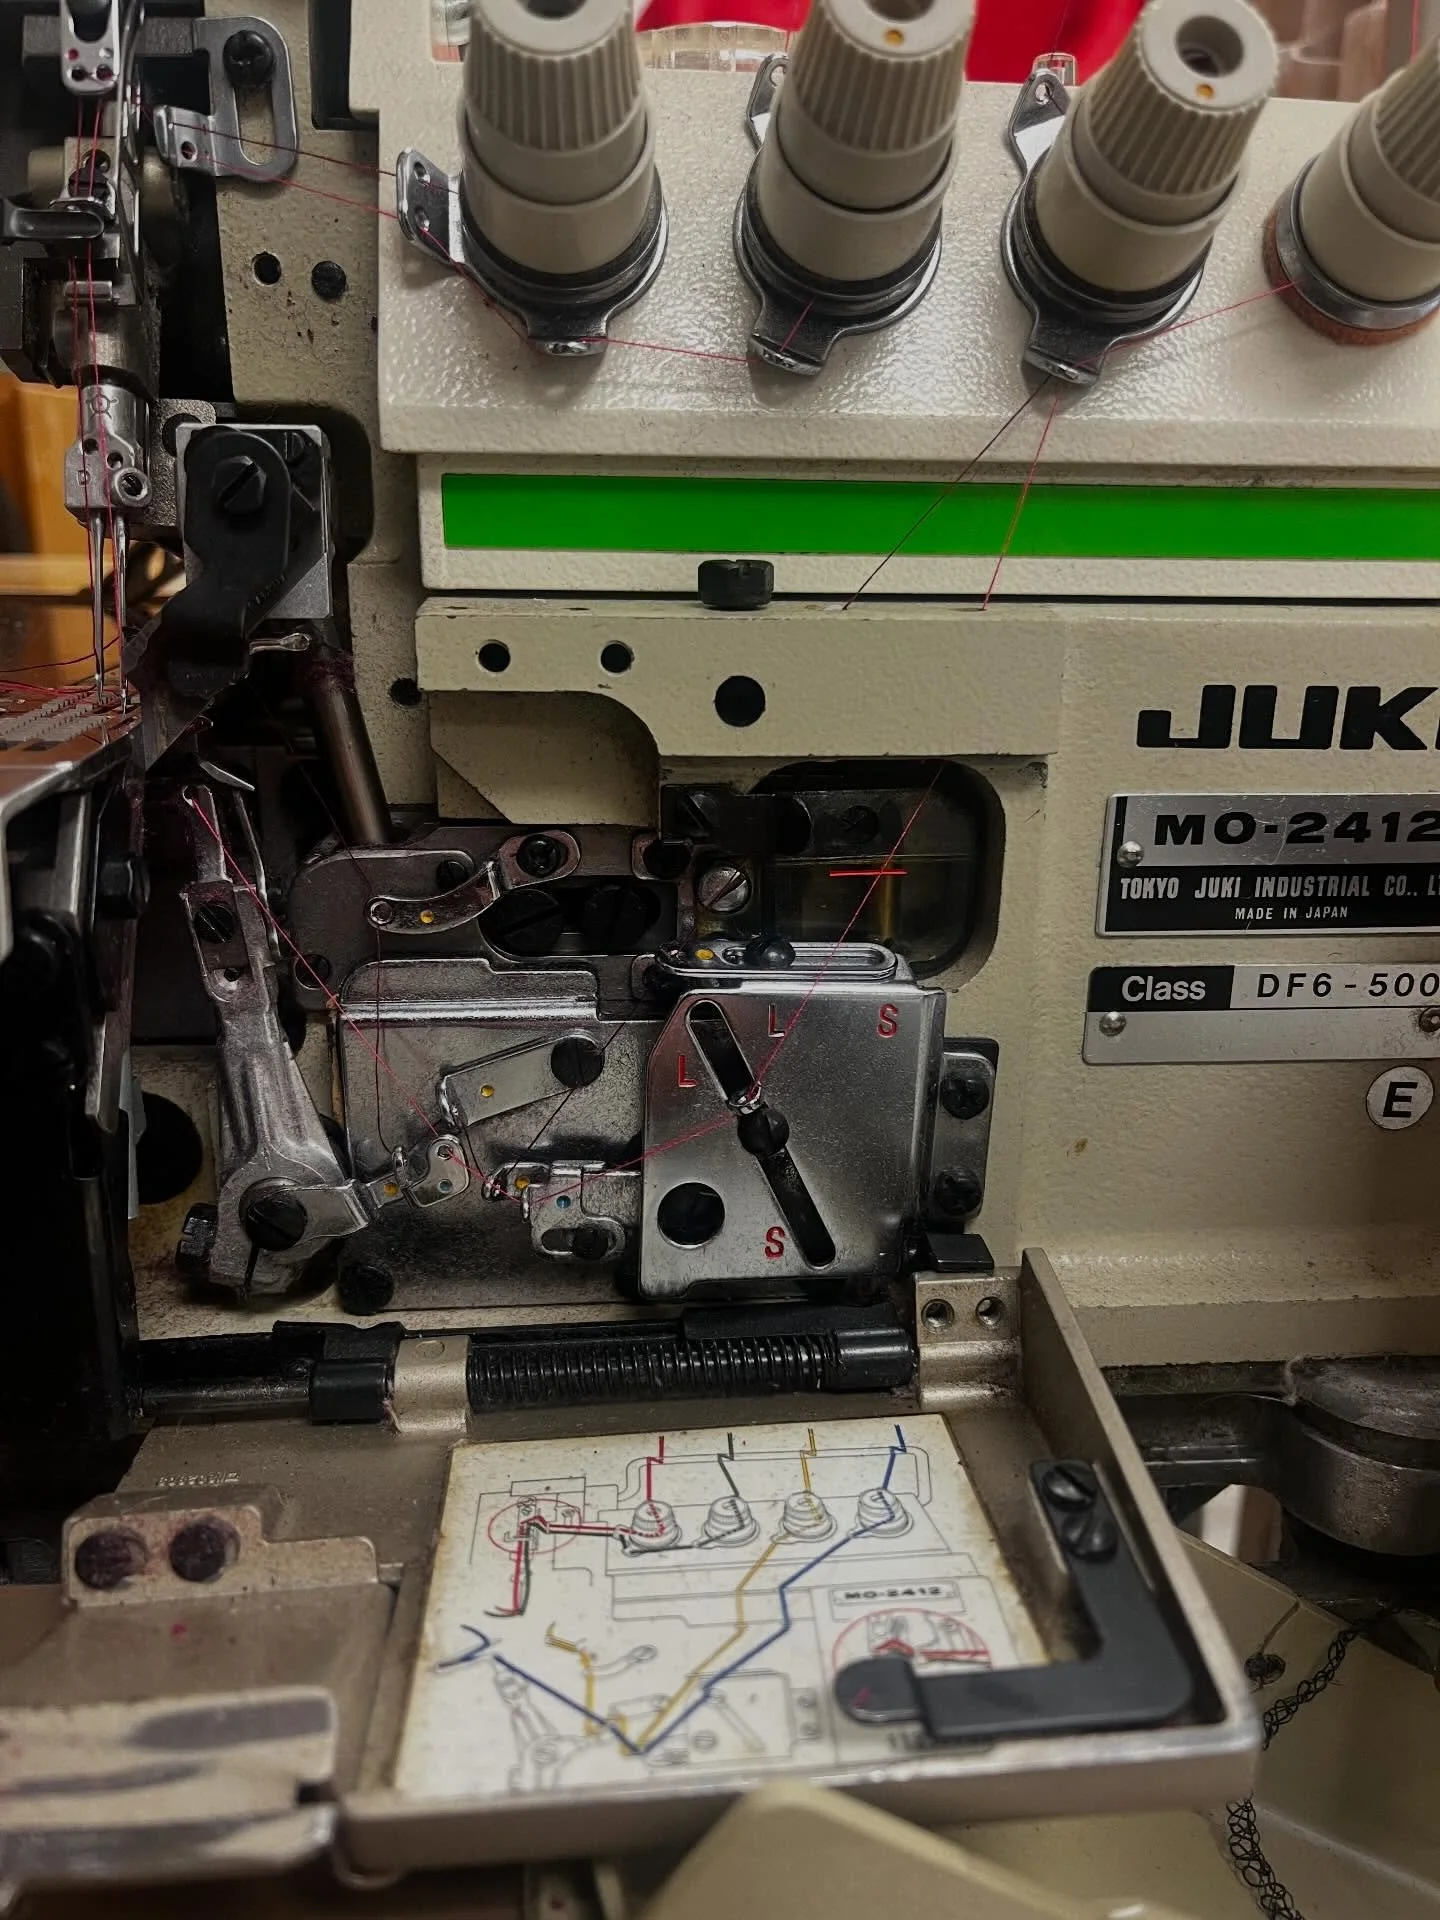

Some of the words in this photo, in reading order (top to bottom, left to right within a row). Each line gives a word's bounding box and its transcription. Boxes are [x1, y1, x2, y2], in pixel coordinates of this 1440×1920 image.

[1136, 684, 1440, 750] JUK
[1154, 811, 1440, 845] MO-2412
[1120, 876, 1180, 900] TOKYO
[1195, 876, 1243, 899] JUKI
[1254, 875, 1370, 898] INDUSTRIAL
[1427, 873, 1440, 896] L
[1235, 907, 1273, 920] MADE
[1283, 906, 1297, 919] IN
[1305, 905, 1348, 919] JAPAN
[1121, 975, 1207, 1002] Class
[767, 1003, 786, 1038] L
[876, 1002, 899, 1038] S
[677, 1054, 697, 1088] L
[1382, 1081, 1418, 1118] E
[764, 1225, 786, 1260] S
[844, 1585, 941, 1600] MO-2412
